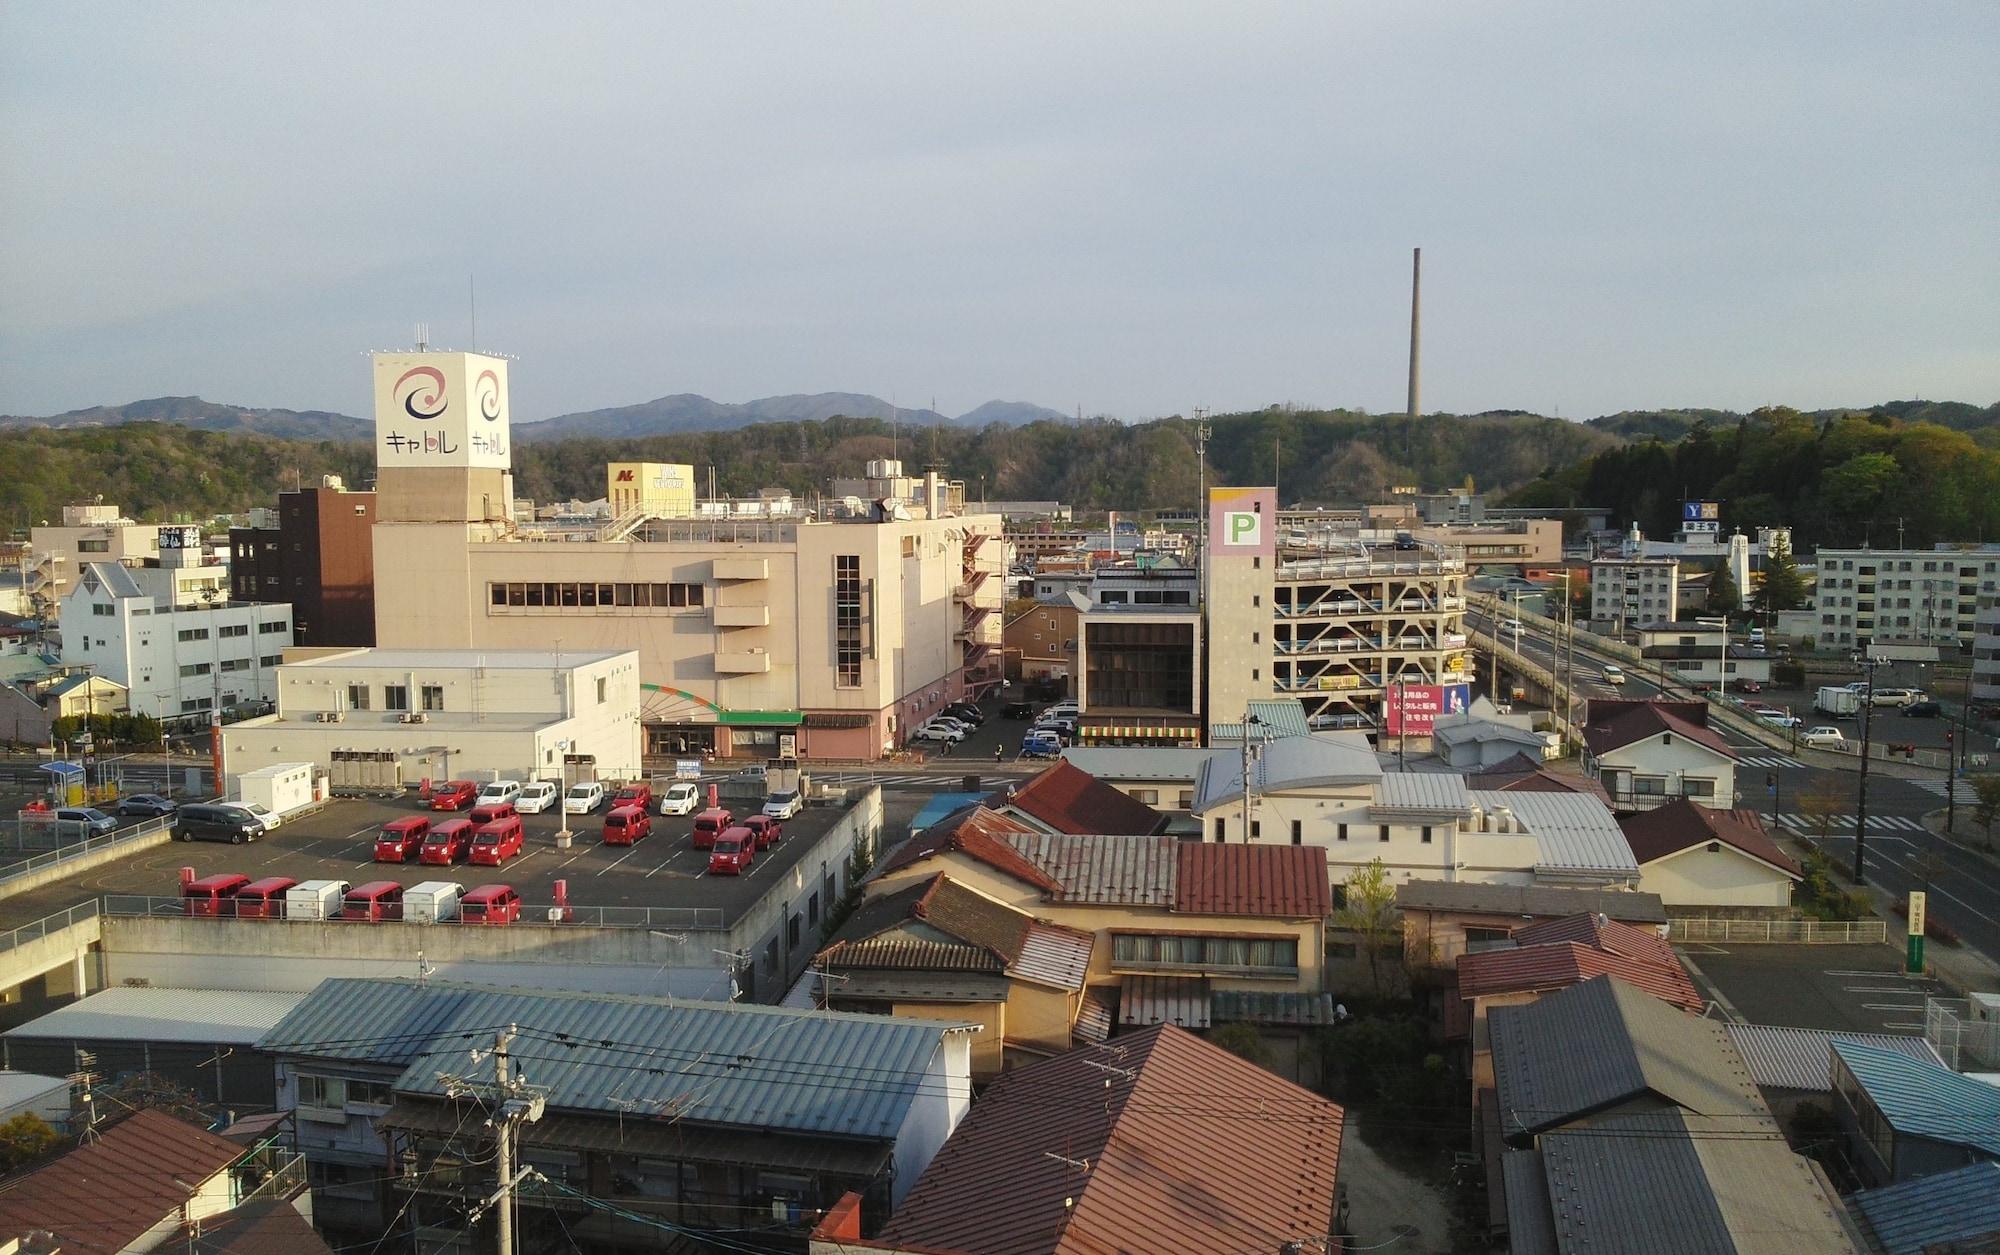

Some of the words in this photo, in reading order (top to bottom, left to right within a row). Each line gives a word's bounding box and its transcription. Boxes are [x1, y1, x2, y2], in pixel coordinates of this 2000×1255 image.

[386, 430, 458, 454] キャトル
[472, 431, 505, 456] キャトル
[1688, 505, 1700, 516] Y
[1232, 514, 1255, 542] P
